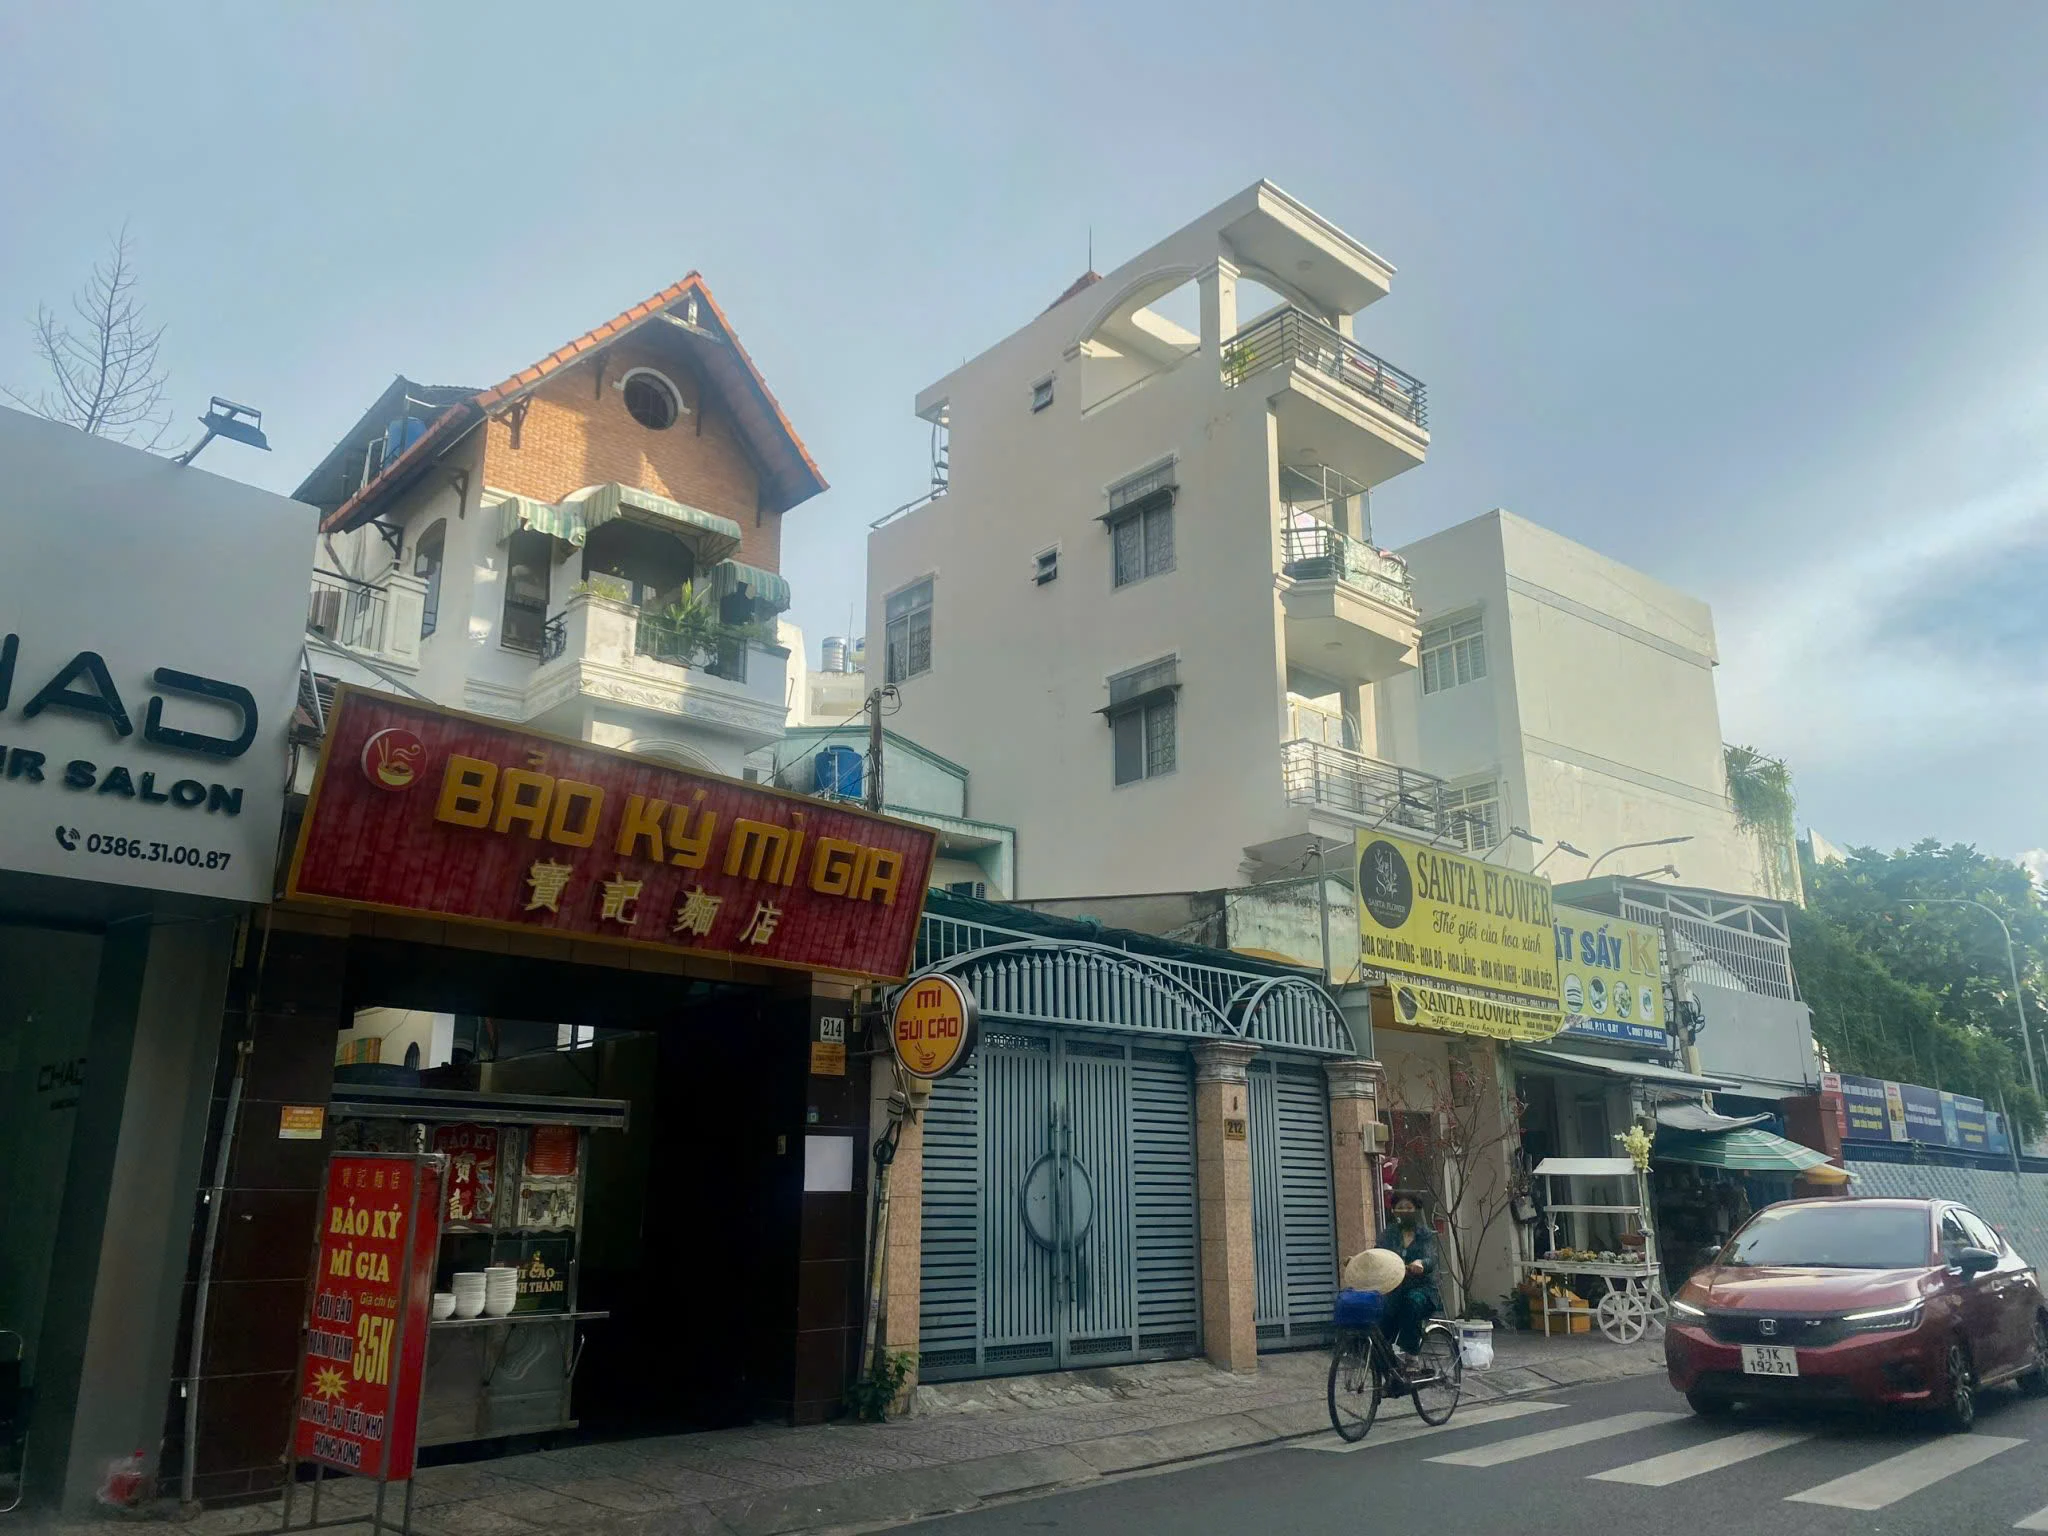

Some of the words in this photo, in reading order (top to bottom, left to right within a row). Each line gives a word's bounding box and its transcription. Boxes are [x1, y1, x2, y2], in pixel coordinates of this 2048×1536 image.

[0, 633, 258, 758] AD
[64, 760, 243, 815] SALON
[434, 749, 605, 848] BẢO
[723, 811, 807, 887] MÌ
[808, 836, 902, 905] GIA
[87, 833, 231, 872] 0386.31.00.87
[1417, 851, 1480, 911] SANTA
[1483, 870, 1552, 928] FLOWER
[1361, 934, 1375, 956] HOA
[1376, 934, 1394, 960] CHÚC
[1420, 946, 1433, 967] HOA
[1432, 910, 1456, 934] Thế
[1459, 920, 1478, 944] giới
[1481, 924, 1498, 945] của
[1501, 927, 1519, 950] hoa
[1522, 933, 1541, 954] xinh
[1580, 921, 1622, 971] SẤY
[917, 987, 941, 1009] MÌ
[1420, 990, 1465, 1016] SANTA
[1469, 1000, 1521, 1026] FLOWER
[823, 1019, 842, 1037] 214
[898, 1015, 922, 1040] SỦI
[927, 1013, 958, 1039] CẢO
[1227, 1121, 1243, 1134] 212
[329, 1195, 368, 1237] BẢO
[329, 1241, 353, 1277] MÌ
[355, 1252, 390, 1283] GIA
[353, 1312, 395, 1385] 35K
[1756, 1347, 1781, 1360] 51K
